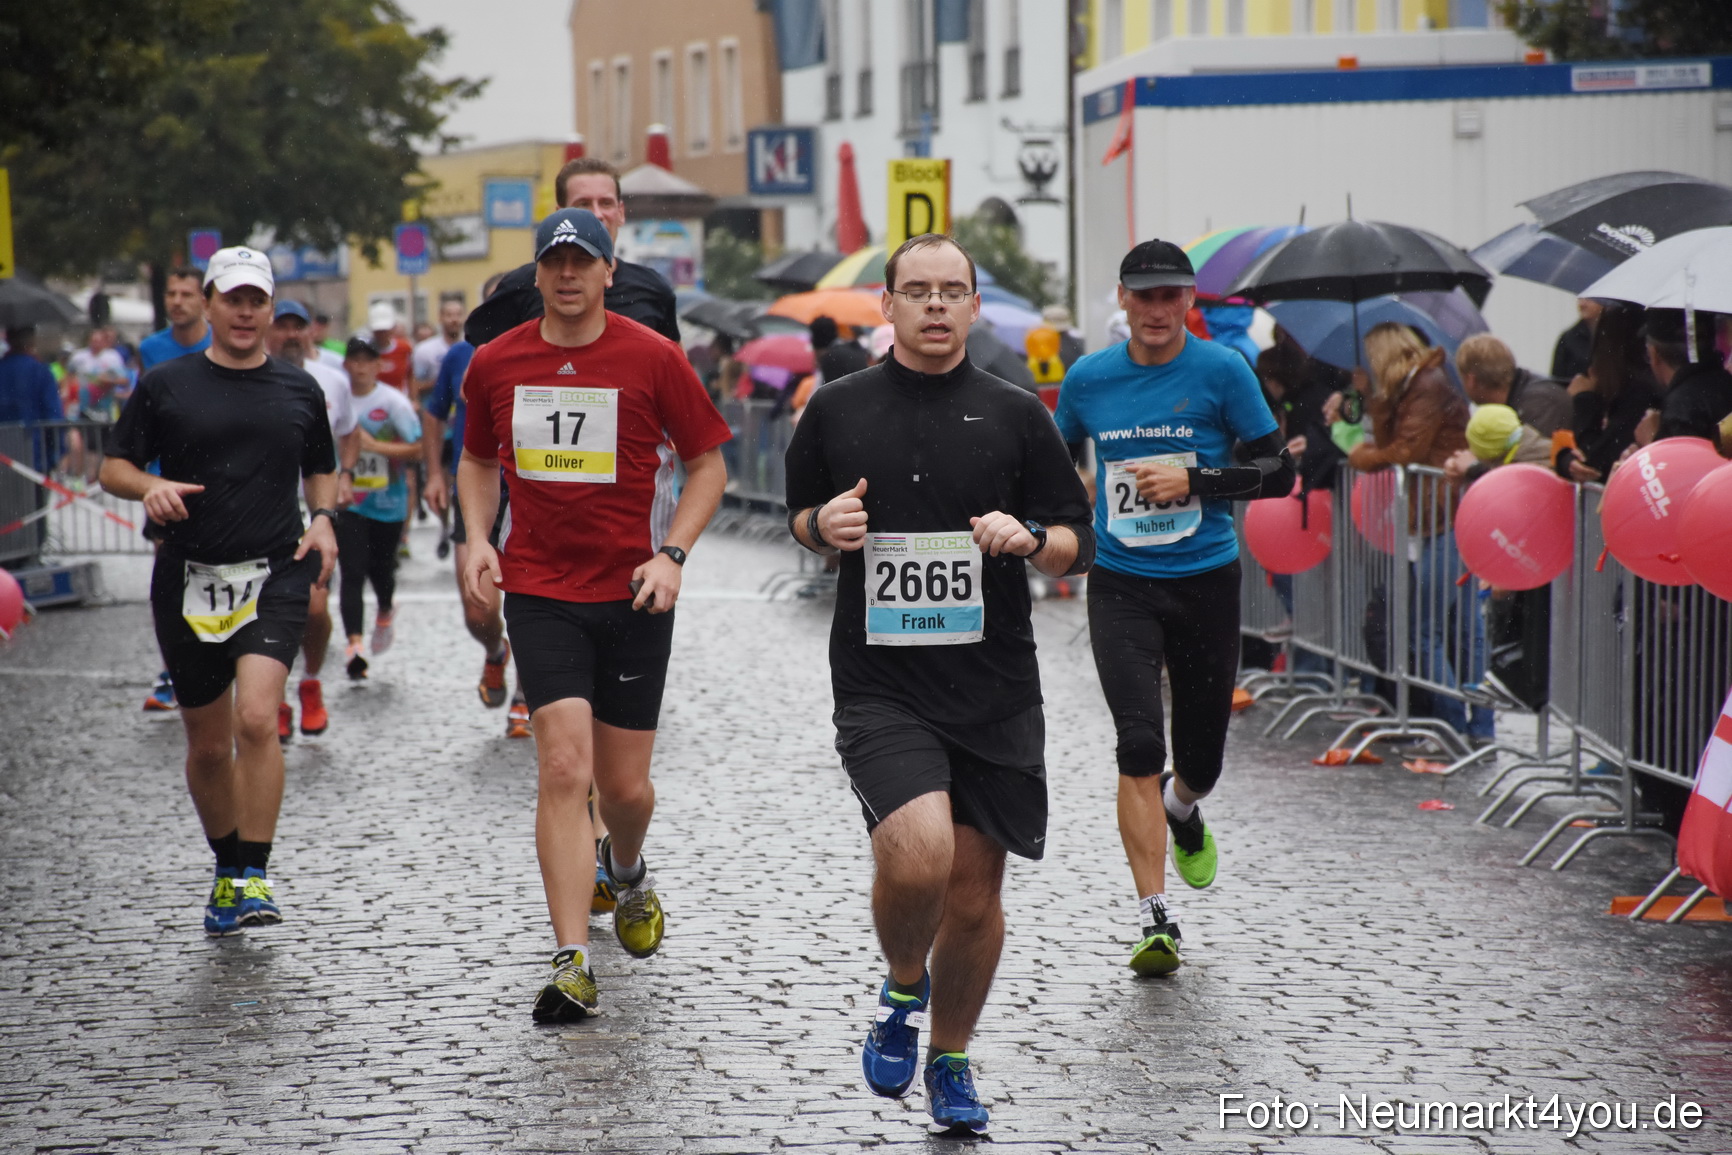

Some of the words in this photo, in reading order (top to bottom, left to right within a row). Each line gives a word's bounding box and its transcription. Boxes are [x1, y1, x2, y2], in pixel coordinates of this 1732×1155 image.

[895, 162, 943, 183] Block
[905, 192, 935, 240] D
[553, 228, 578, 236] adidas
[560, 391, 608, 404] BOCK
[545, 410, 587, 446] 17
[1098, 424, 1194, 442] www.hasit.de
[544, 453, 585, 469] Oliver
[1135, 519, 1176, 534] Hubert
[872, 545, 908, 553] NeuerMarkt
[915, 536, 971, 550] BOCK
[876, 560, 972, 602] 2665
[901, 612, 946, 630] Frank
